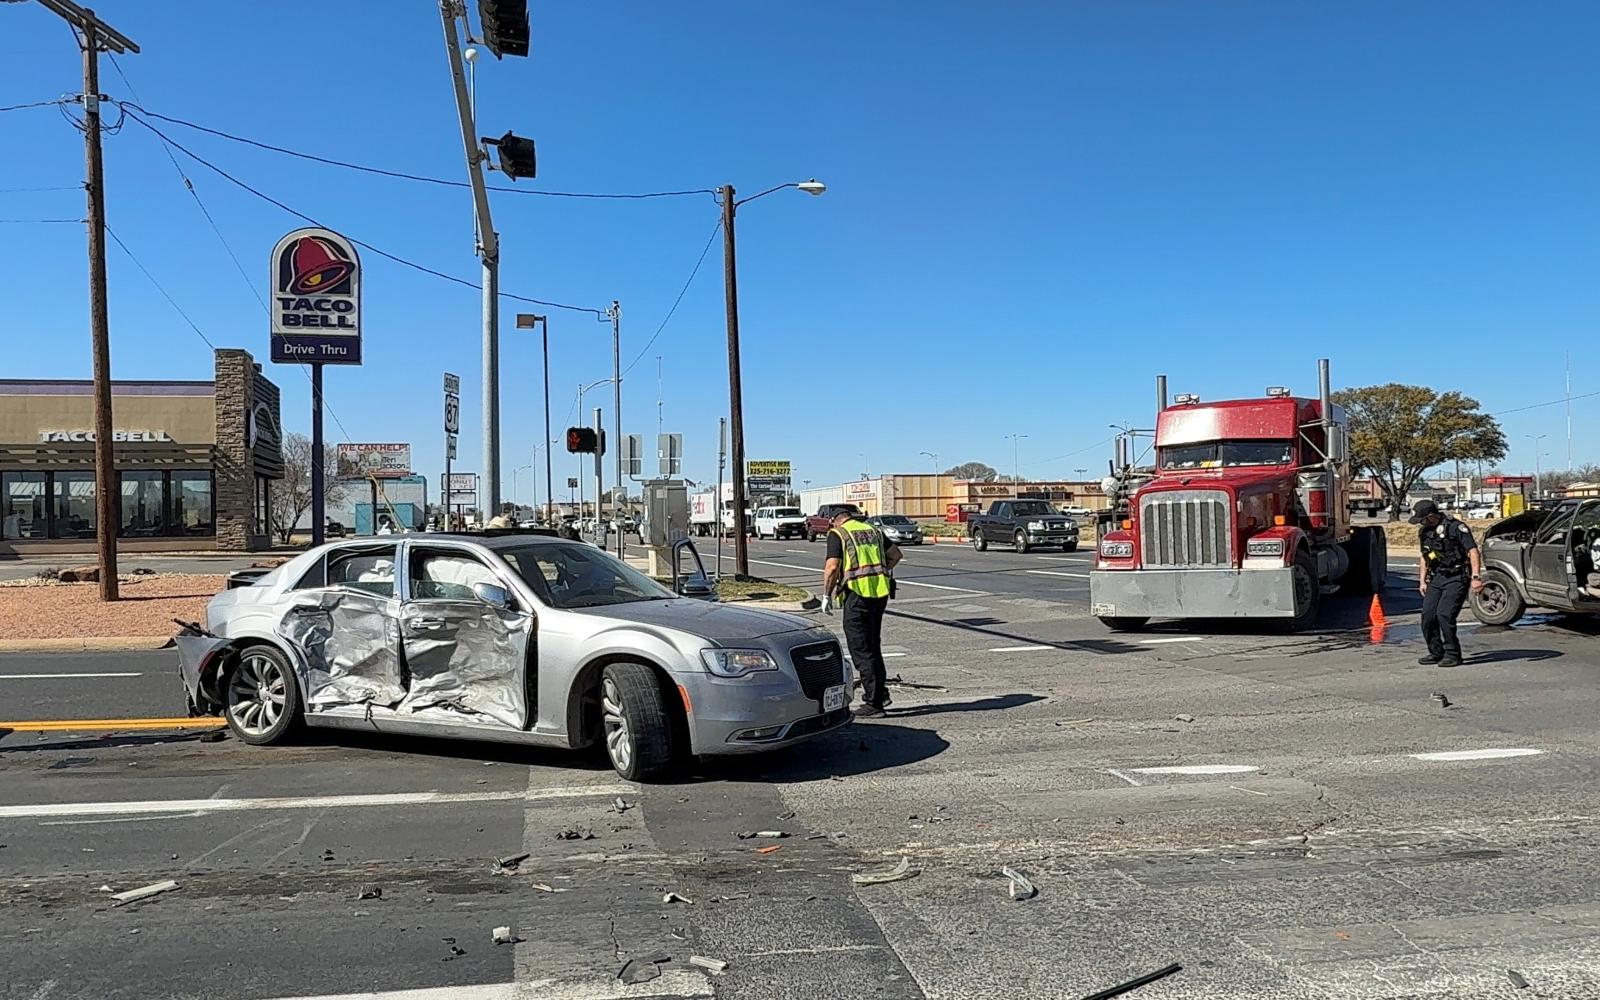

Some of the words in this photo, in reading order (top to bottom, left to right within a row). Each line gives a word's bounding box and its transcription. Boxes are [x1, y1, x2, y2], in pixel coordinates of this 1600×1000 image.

[276, 297, 354, 313] TACO
[281, 313, 355, 328] BELL
[284, 343, 315, 354] Drive
[320, 344, 347, 355] Thru
[446, 402, 458, 424] 87
[112, 430, 173, 442] BELL
